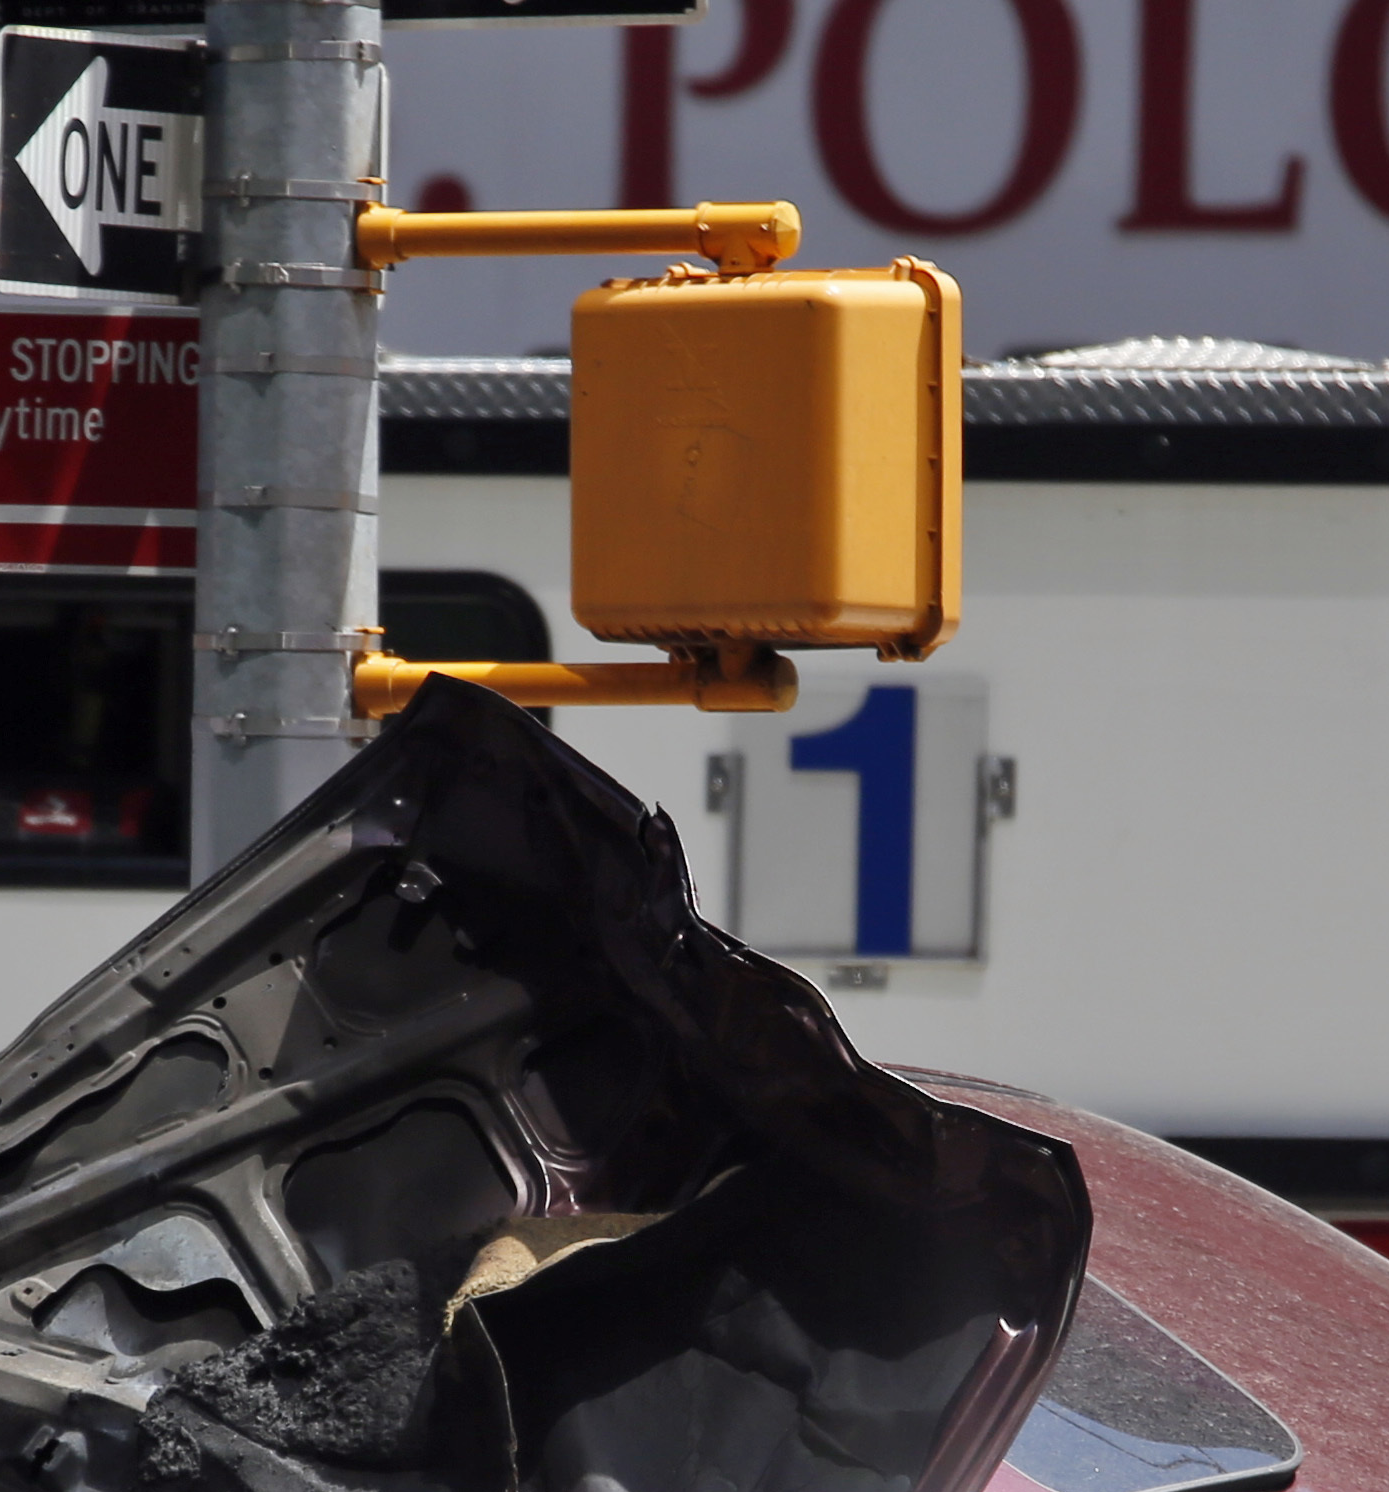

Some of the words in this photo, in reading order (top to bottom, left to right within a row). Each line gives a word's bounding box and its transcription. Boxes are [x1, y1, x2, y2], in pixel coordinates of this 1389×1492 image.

[60, 117, 162, 217] ONE
[11, 337, 200, 387] STOPPING
[789, 686, 918, 957] 1
